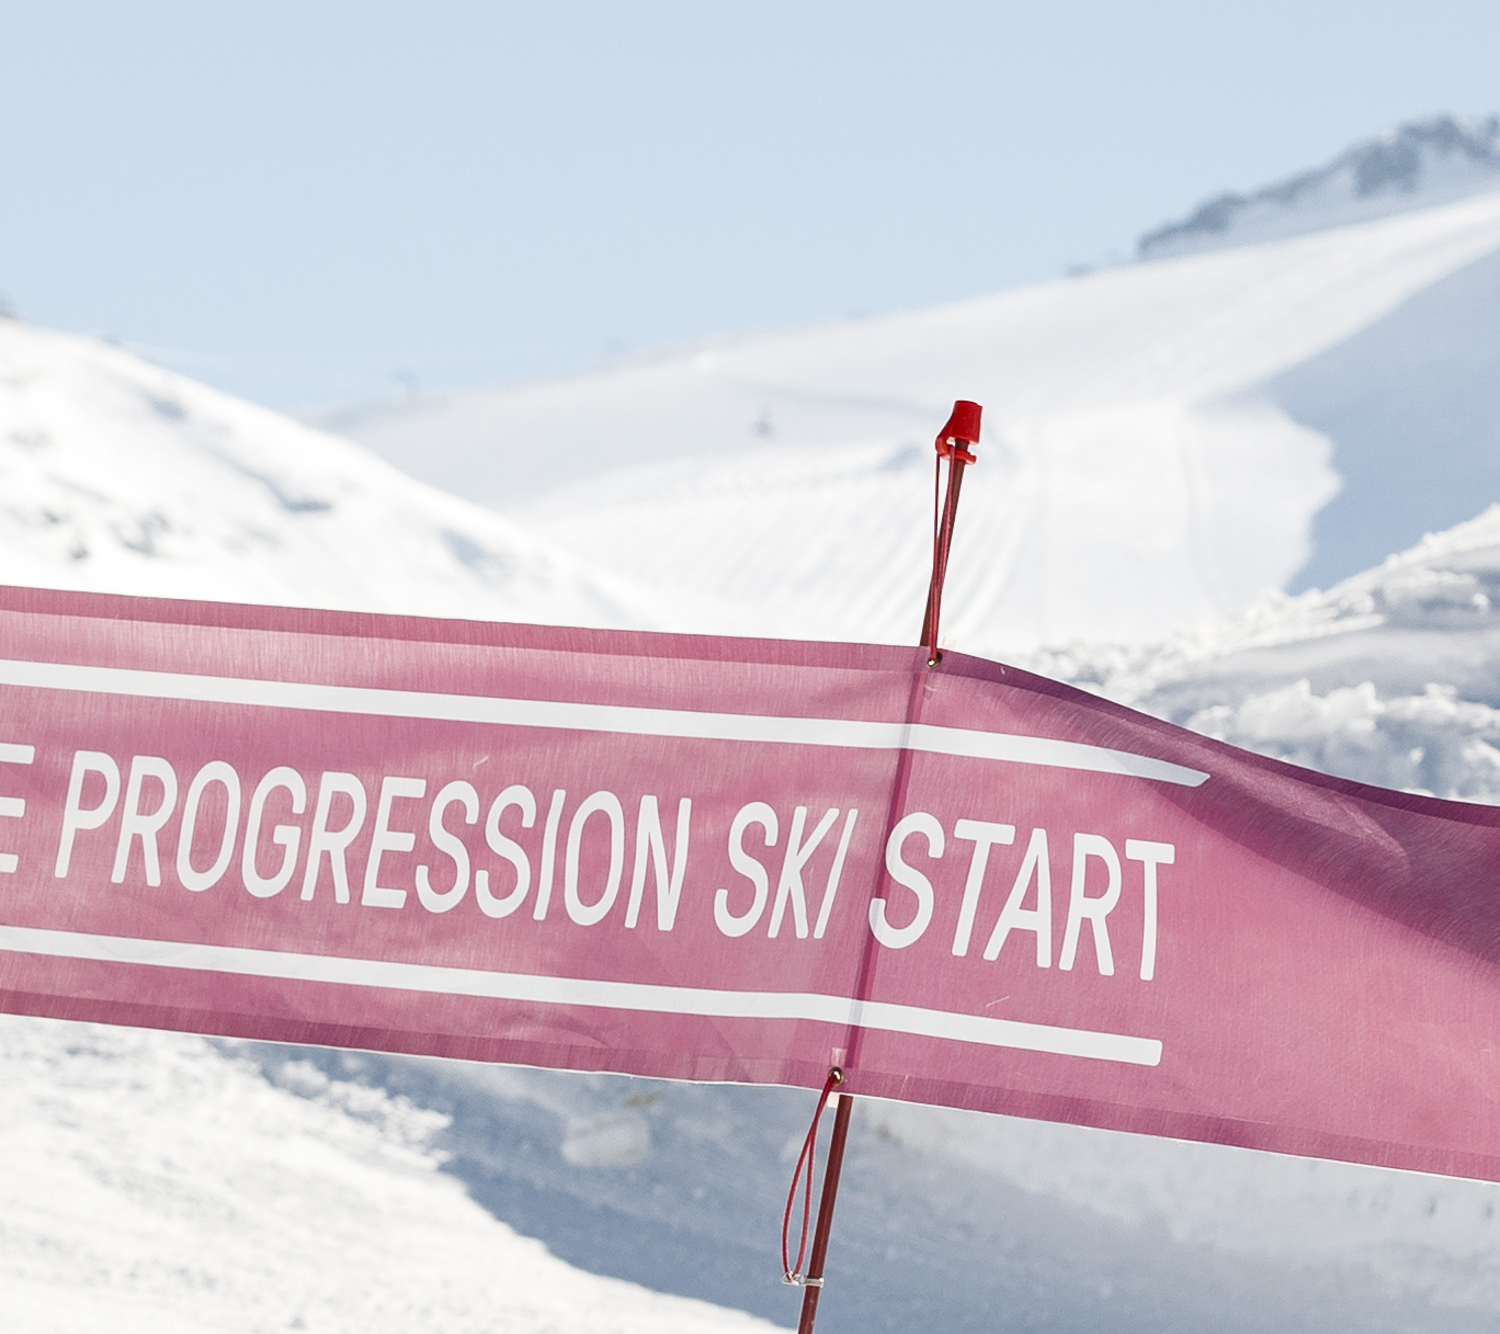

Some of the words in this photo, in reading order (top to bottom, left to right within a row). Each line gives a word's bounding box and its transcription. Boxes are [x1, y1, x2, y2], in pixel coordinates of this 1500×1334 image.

[54, 750, 692, 932] PROGRESSION
[714, 801, 858, 939] SKI
[868, 812, 1175, 981] START
